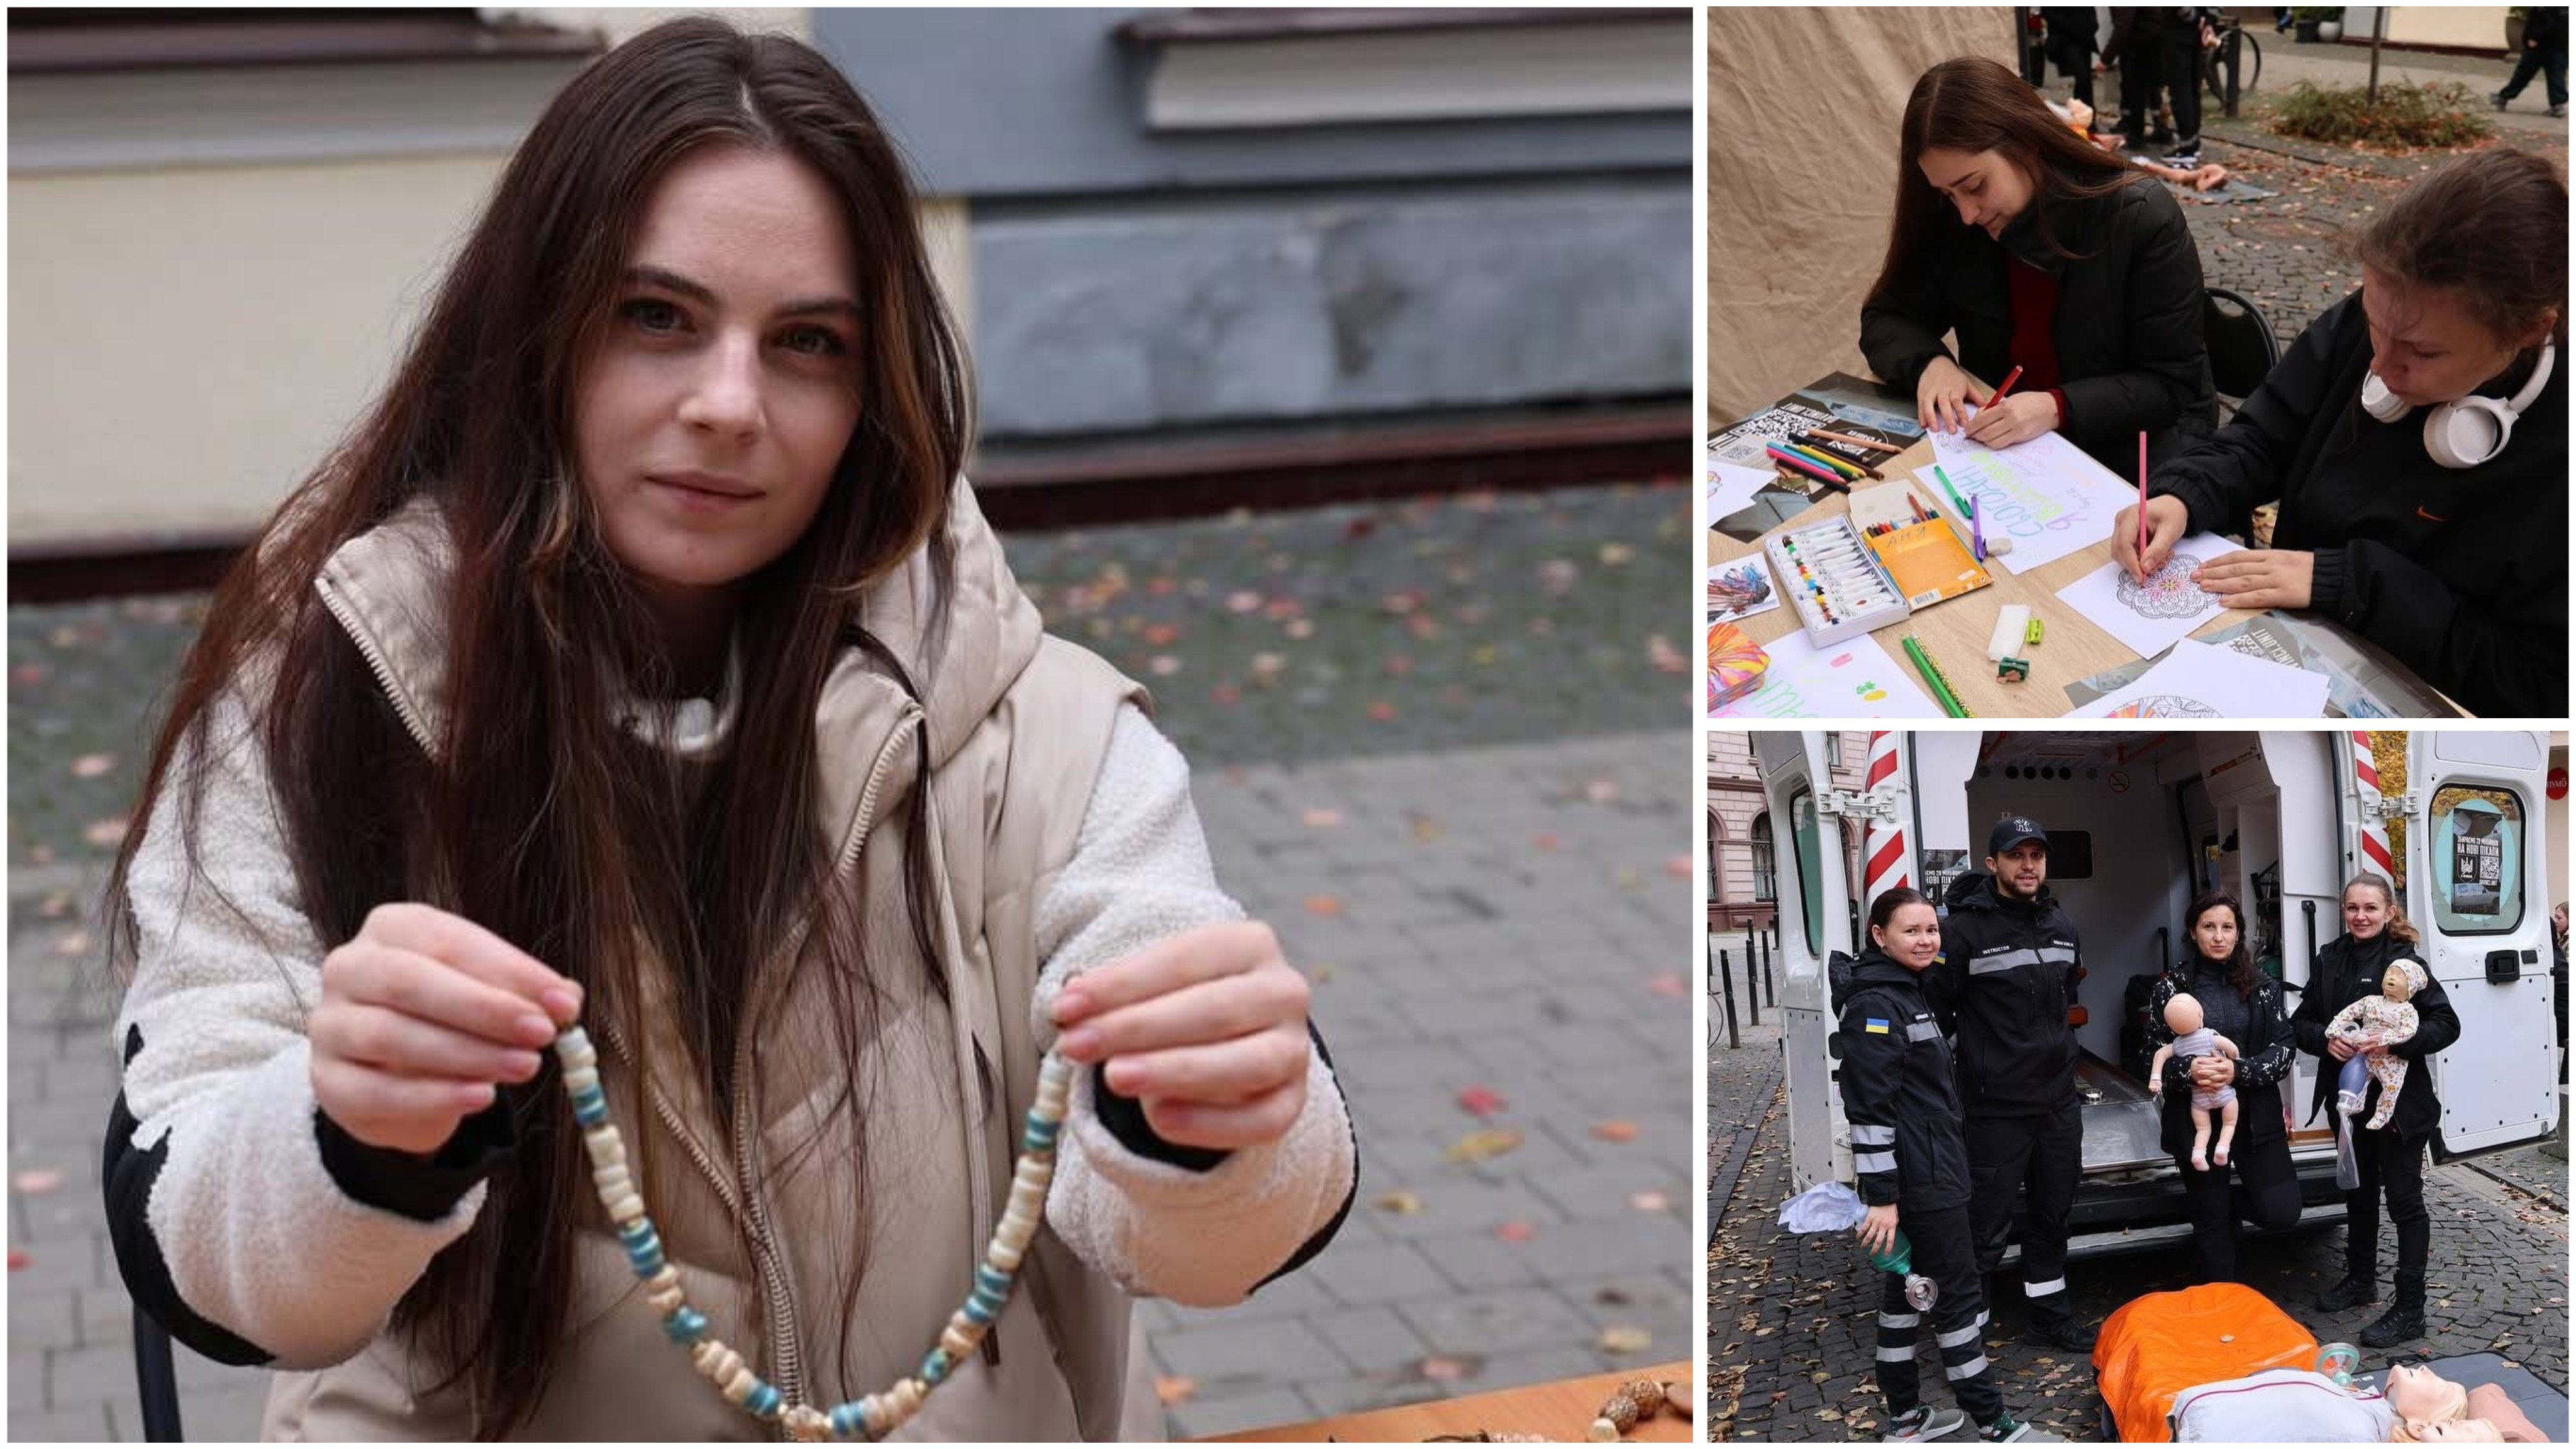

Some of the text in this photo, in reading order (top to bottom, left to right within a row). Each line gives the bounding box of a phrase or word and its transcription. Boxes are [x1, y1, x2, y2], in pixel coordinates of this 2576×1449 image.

[2251, 629, 2299, 665] VINCI.UNIT
[2457, 843, 2465, 853] НА
[2467, 844, 2479, 855] НОВІ
[1982, 945, 2010, 955] INSTRUCTOR
